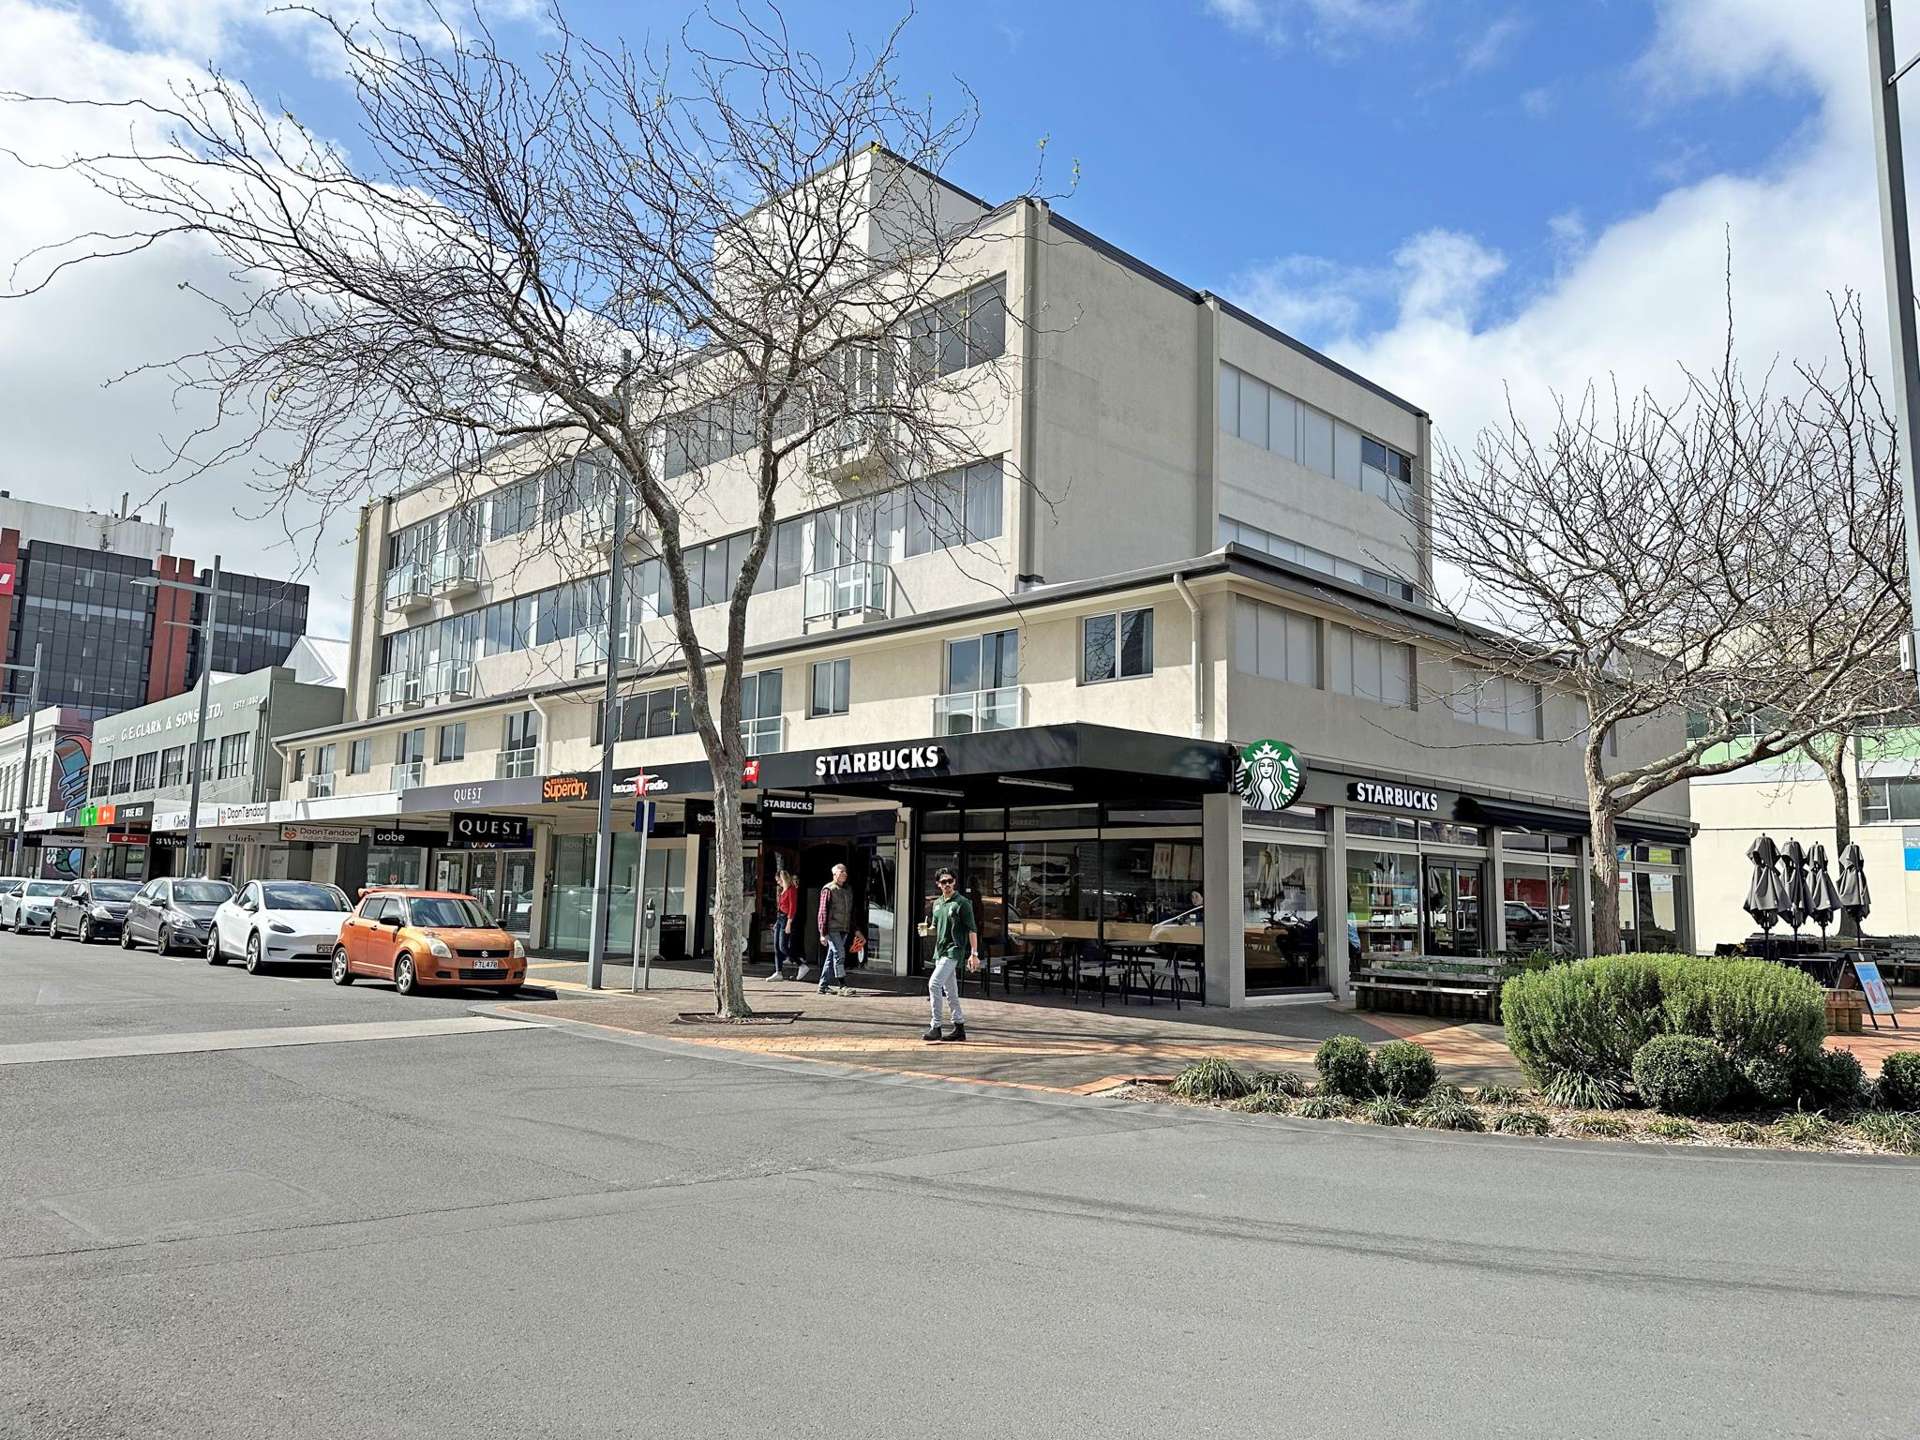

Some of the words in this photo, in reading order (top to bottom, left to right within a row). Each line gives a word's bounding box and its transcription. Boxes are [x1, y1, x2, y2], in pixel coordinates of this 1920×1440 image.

[166, 718, 173, 731] &
[175, 710, 200, 728] SONS
[815, 745, 939, 776] STARBUCKS
[612, 783, 637, 794] texas
[645, 778, 669, 791] radio
[453, 787, 483, 803] QUEST
[1357, 782, 1438, 811] STARBUCKS
[763, 799, 813, 811] STARBUCKS
[459, 819, 524, 836] QUEST
[377, 831, 405, 842] oobe
